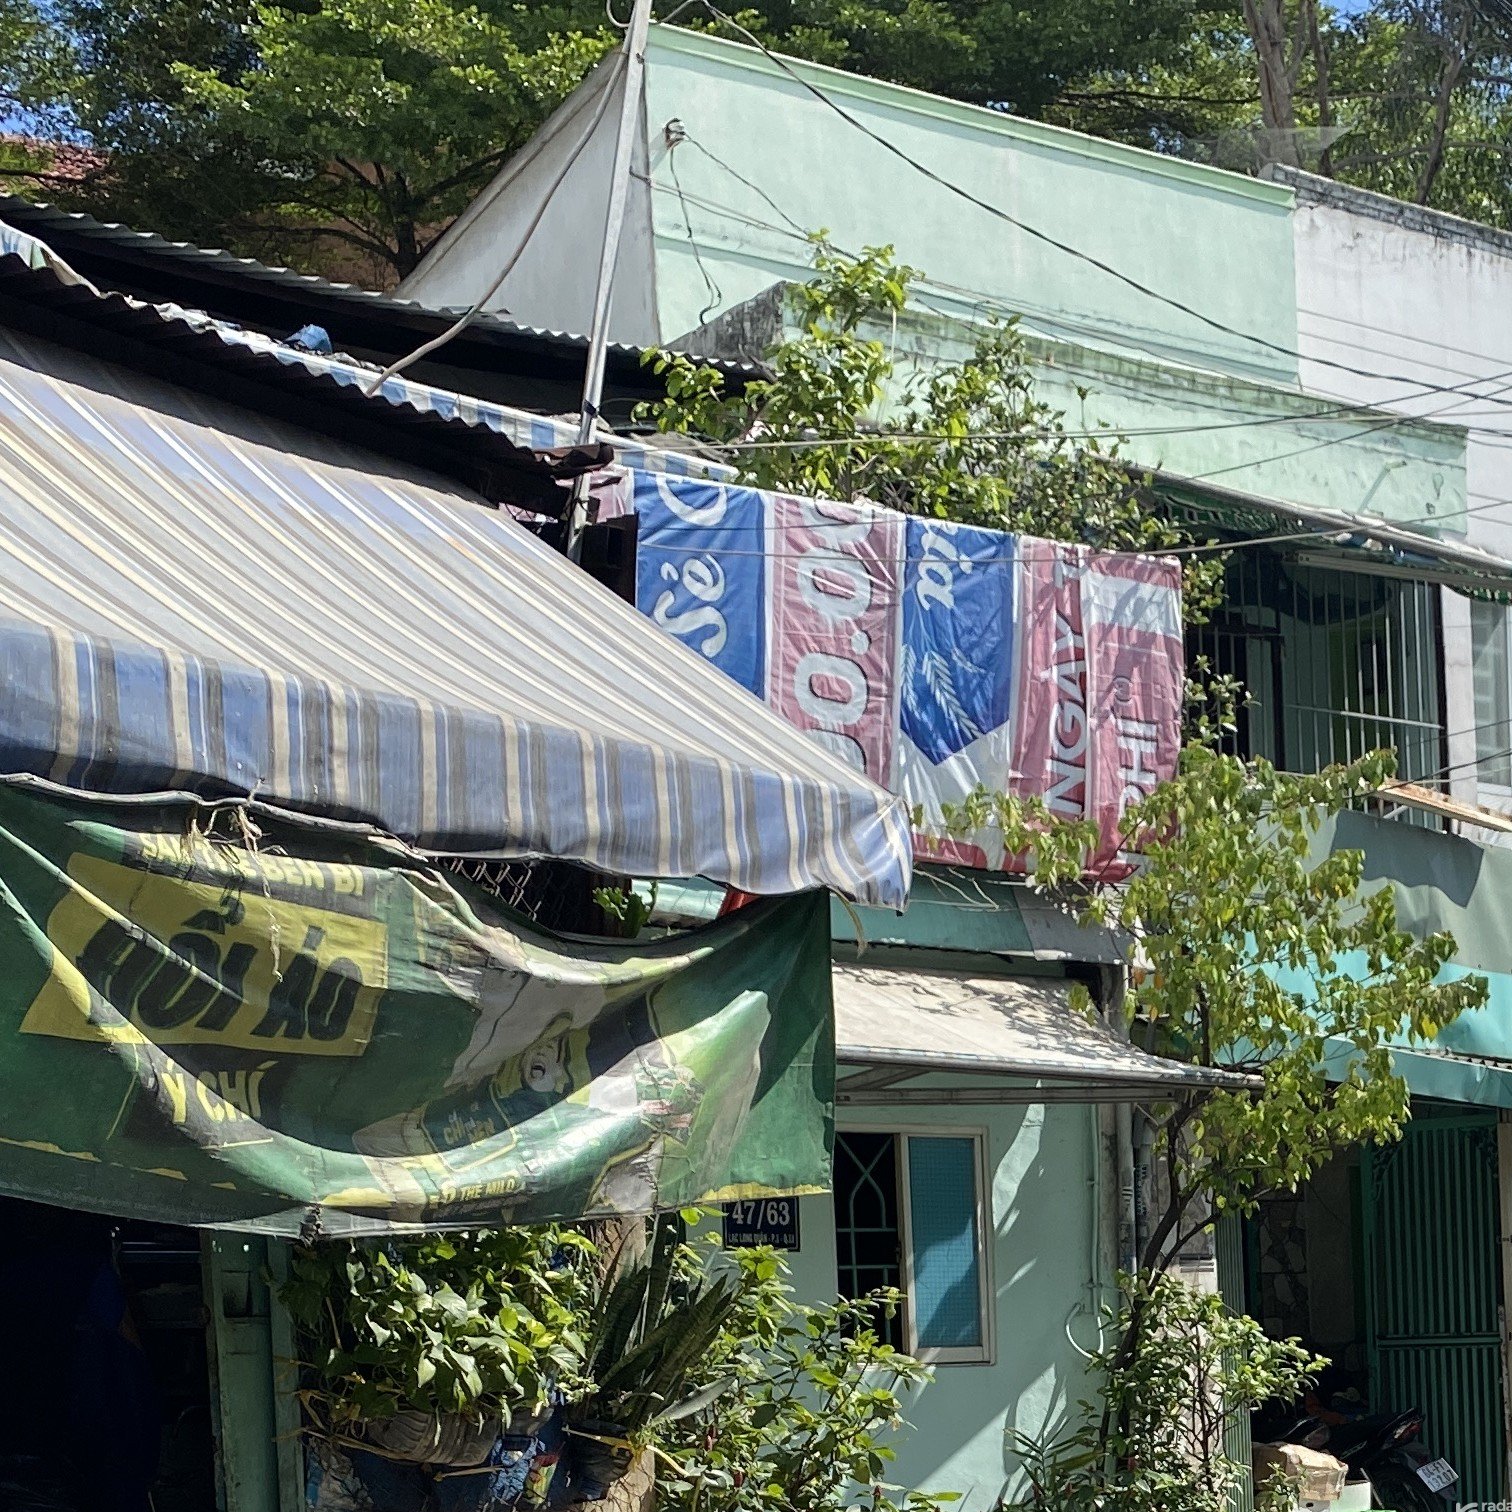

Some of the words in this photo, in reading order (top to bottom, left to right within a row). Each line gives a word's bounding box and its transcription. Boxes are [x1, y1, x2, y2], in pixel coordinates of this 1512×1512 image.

[250, 924, 362, 1042] ÁO
[161, 1057, 188, 1125] Ý
[196, 1060, 279, 1124] CHÍ
[732, 1199, 790, 1229] 47/63
